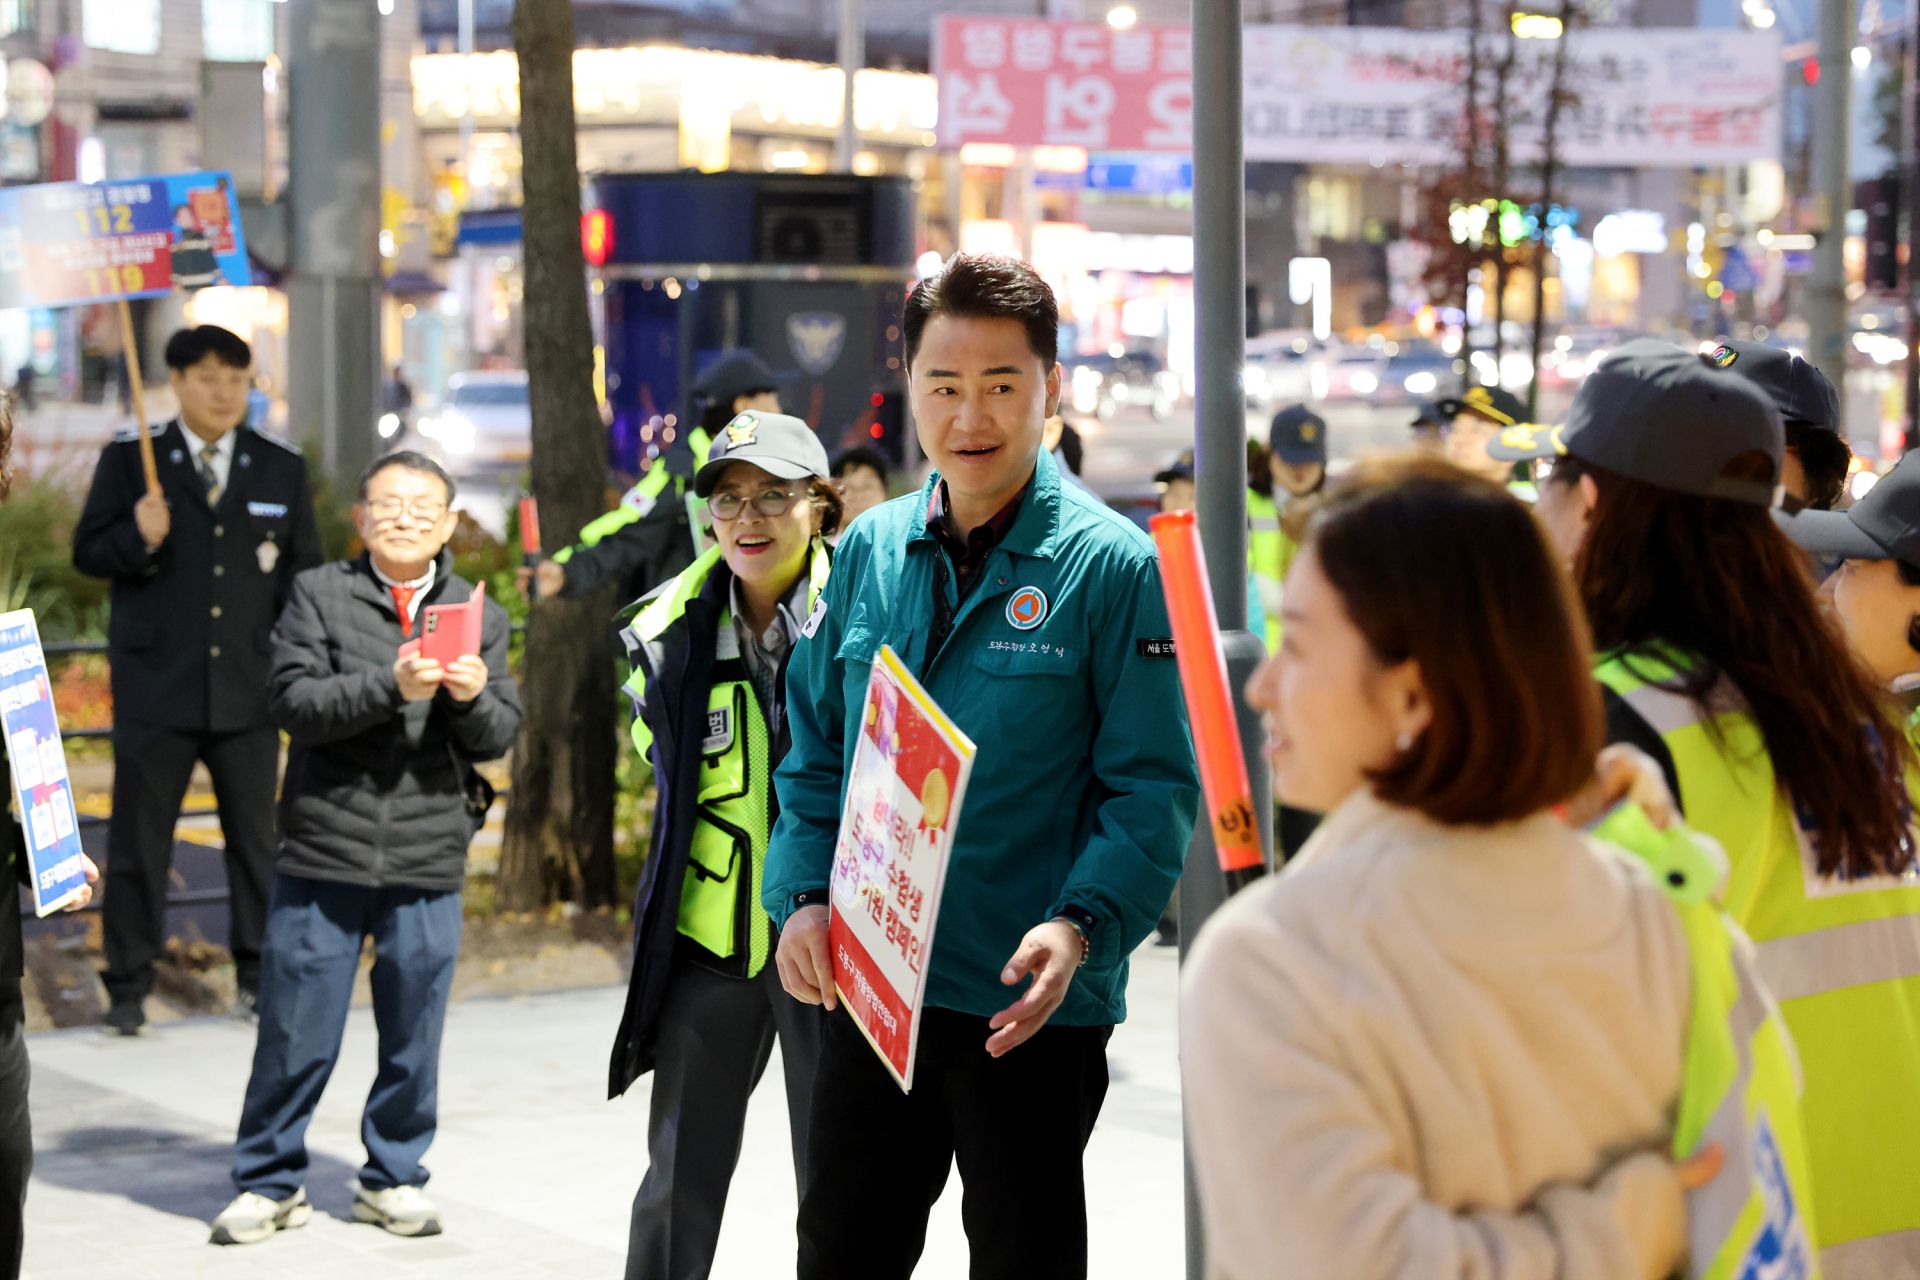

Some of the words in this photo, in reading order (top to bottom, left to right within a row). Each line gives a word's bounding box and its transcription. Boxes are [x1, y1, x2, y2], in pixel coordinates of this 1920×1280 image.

[75, 203, 135, 236] 112
[84, 264, 145, 295] 119
[1147, 643, 1161, 654] 서울
[885, 858, 924, 923] 수험생
[885, 905, 926, 975] 캠페인
[837, 943, 855, 977] 도봉구
